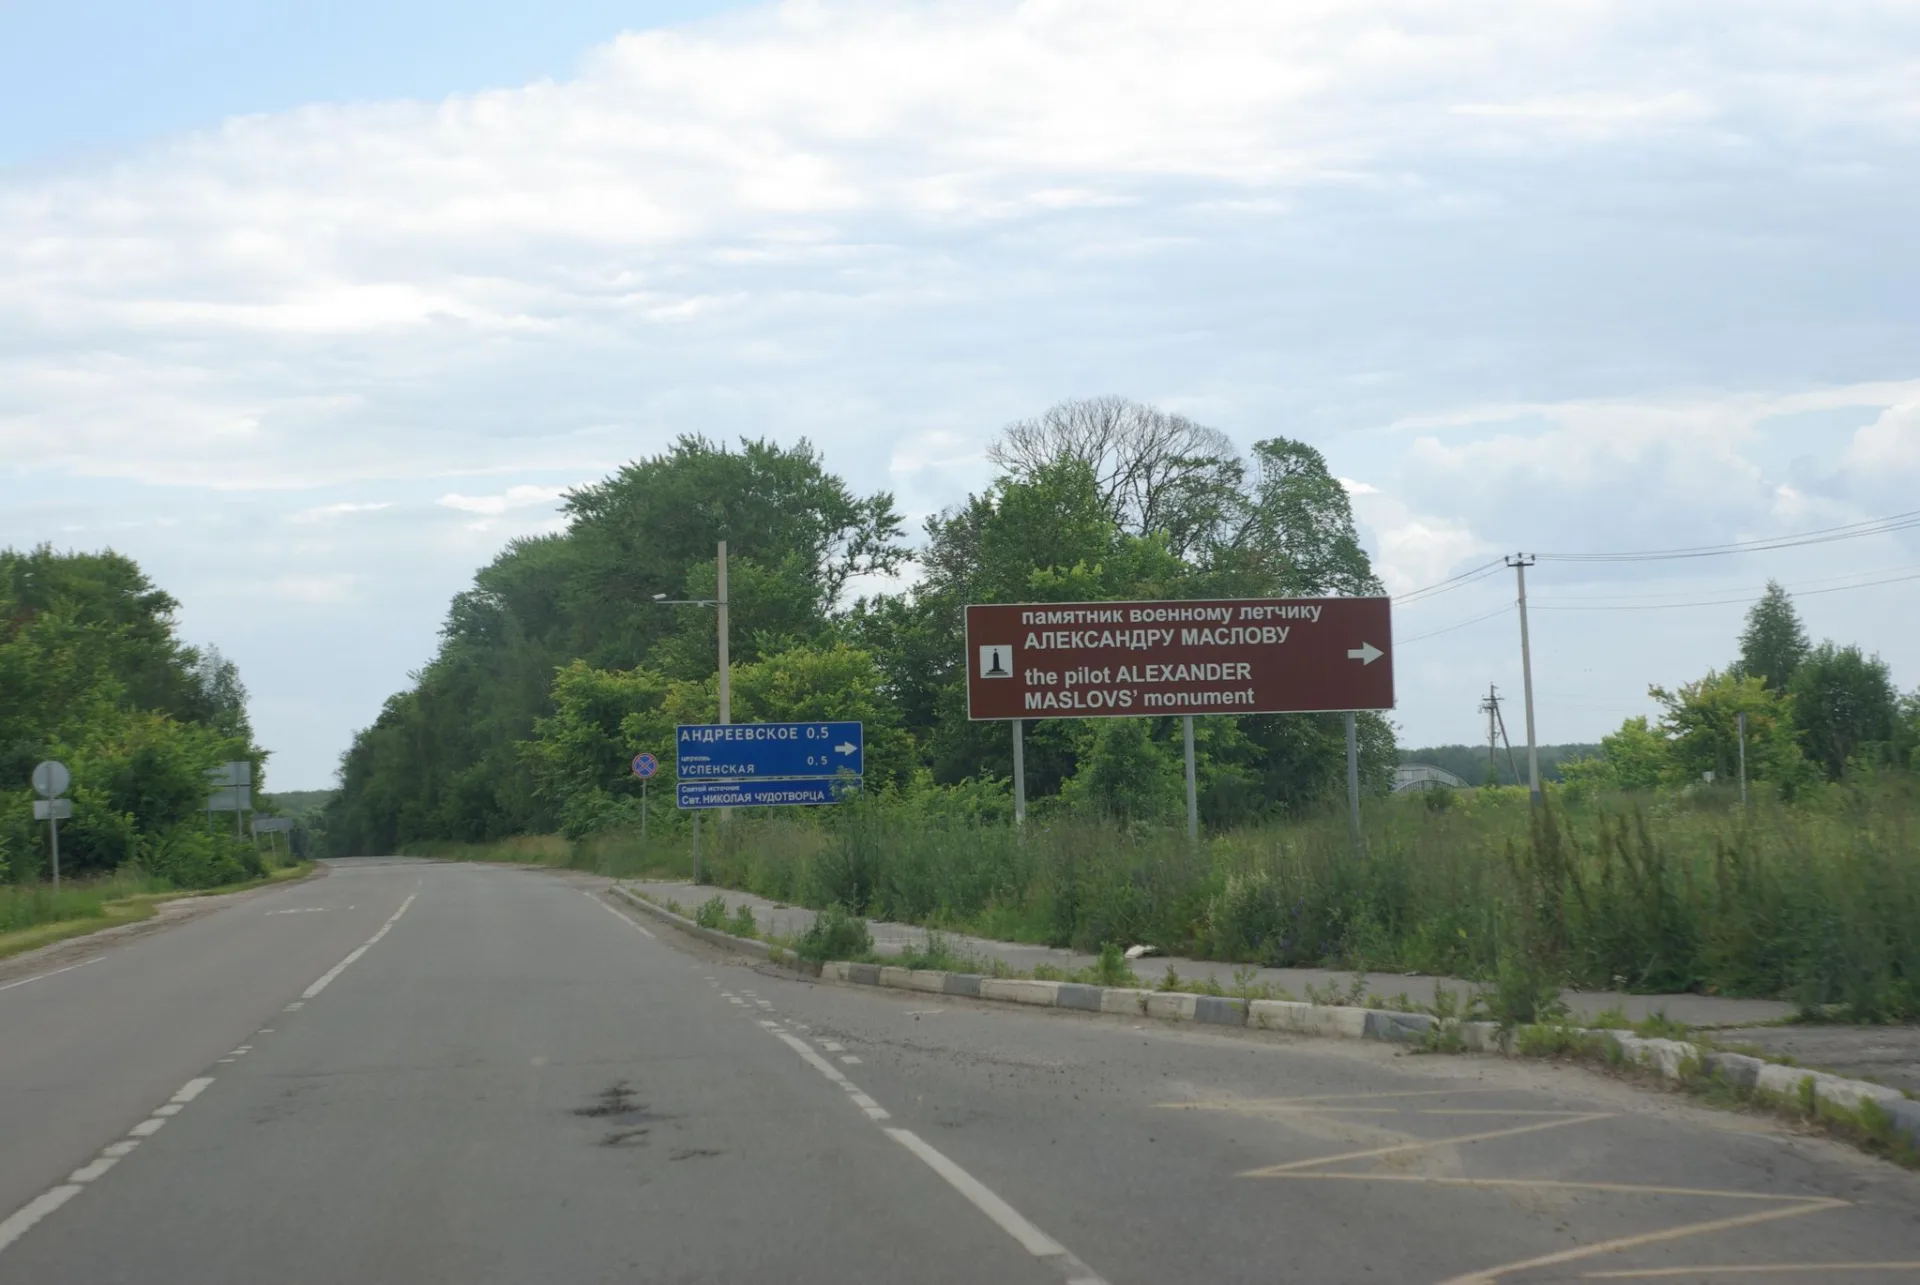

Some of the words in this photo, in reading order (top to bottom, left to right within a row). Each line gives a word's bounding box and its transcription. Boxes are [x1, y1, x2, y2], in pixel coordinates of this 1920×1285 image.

[1022, 610, 1123, 625] памятник
[1130, 607, 1233, 624] военному
[1239, 605, 1322, 622] летчику
[1024, 629, 1175, 650] АЛЕКСАНДРУ
[1182, 626, 1290, 645] МАСЛОВУ
[1024, 668, 1057, 685] the
[1065, 667, 1111, 688] pilot
[1116, 663, 1252, 682] ALEXANDER
[1144, 688, 1254, 706] monument
[681, 728, 798, 742] АНДРЕЕВСКОЕ
[806, 727, 829, 740] 0,5
[807, 756, 828, 766] 0,5
[681, 764, 755, 775] УСПЕНСКАЯ
[703, 793, 751, 803] НИКОЛАЯ
[755, 791, 824, 802] ЧУДОТВОРЦА
